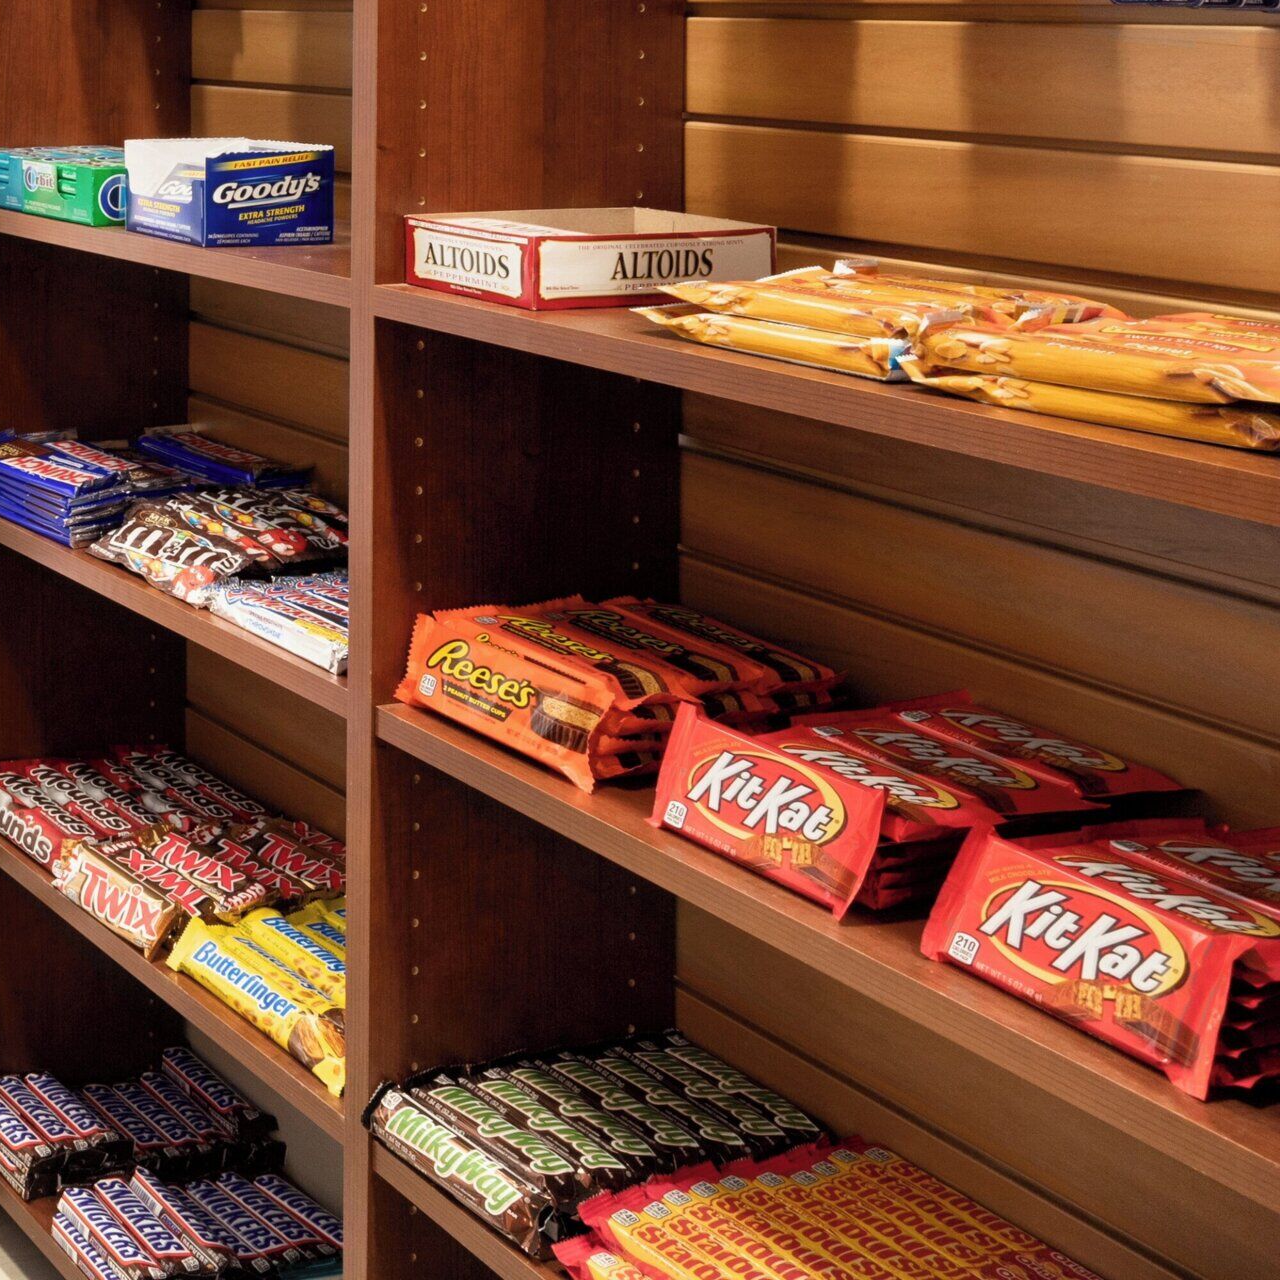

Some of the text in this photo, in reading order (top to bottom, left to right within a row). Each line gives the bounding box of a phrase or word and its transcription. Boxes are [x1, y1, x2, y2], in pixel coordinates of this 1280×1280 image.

[234, 154, 311, 169] FAST PAIN RELIEF
[25, 166, 54, 192] Orbit
[212, 172, 321, 205] Goody's
[153, 201, 181, 213] STRENGTH
[239, 205, 305, 221] EXTRA STRENGTH
[424, 242, 510, 280] ALTOIDS
[579, 239, 744, 251] THE ORIGINAL CELEBRATED CURIOUSLY STRONG MINTS
[433, 269, 499, 290] PEPPERMINT
[611, 248, 714, 281] ALTOIDS
[1124, 341, 1192, 356] Peanut
[6, 456, 94, 485] CRUNCH
[423, 674, 436, 687] 210
[447, 685, 506, 719] PEANUT BUTTER CUPS
[30, 764, 130, 833] Mounds
[126, 752, 234, 819] Mounds
[154, 749, 265, 815] Mounds
[668, 801, 684, 817] 210
[1004, 869, 1052, 881] CHOCOLATE
[956, 934, 977, 952] 210
[192, 939, 298, 1019] Butterfinger
[164, 1047, 241, 1109] SNICKERS
[27, 1073, 102, 1133] SNICKERS
[84, 1084, 161, 1145] SNICKERS
[113, 1082, 193, 1144] SNICKERS
[142, 1071, 223, 1136] SNICKERS
[218, 1172, 318, 1244] SNICKERS
[651, 1202, 671, 1216] 240
[669, 1190, 690, 1205] 240
[64, 1186, 146, 1266] SNICKERS
[96, 1178, 182, 1256] SNICKERS
[188, 1180, 286, 1250] SNICKERS
[618, 1209, 638, 1223] 240
